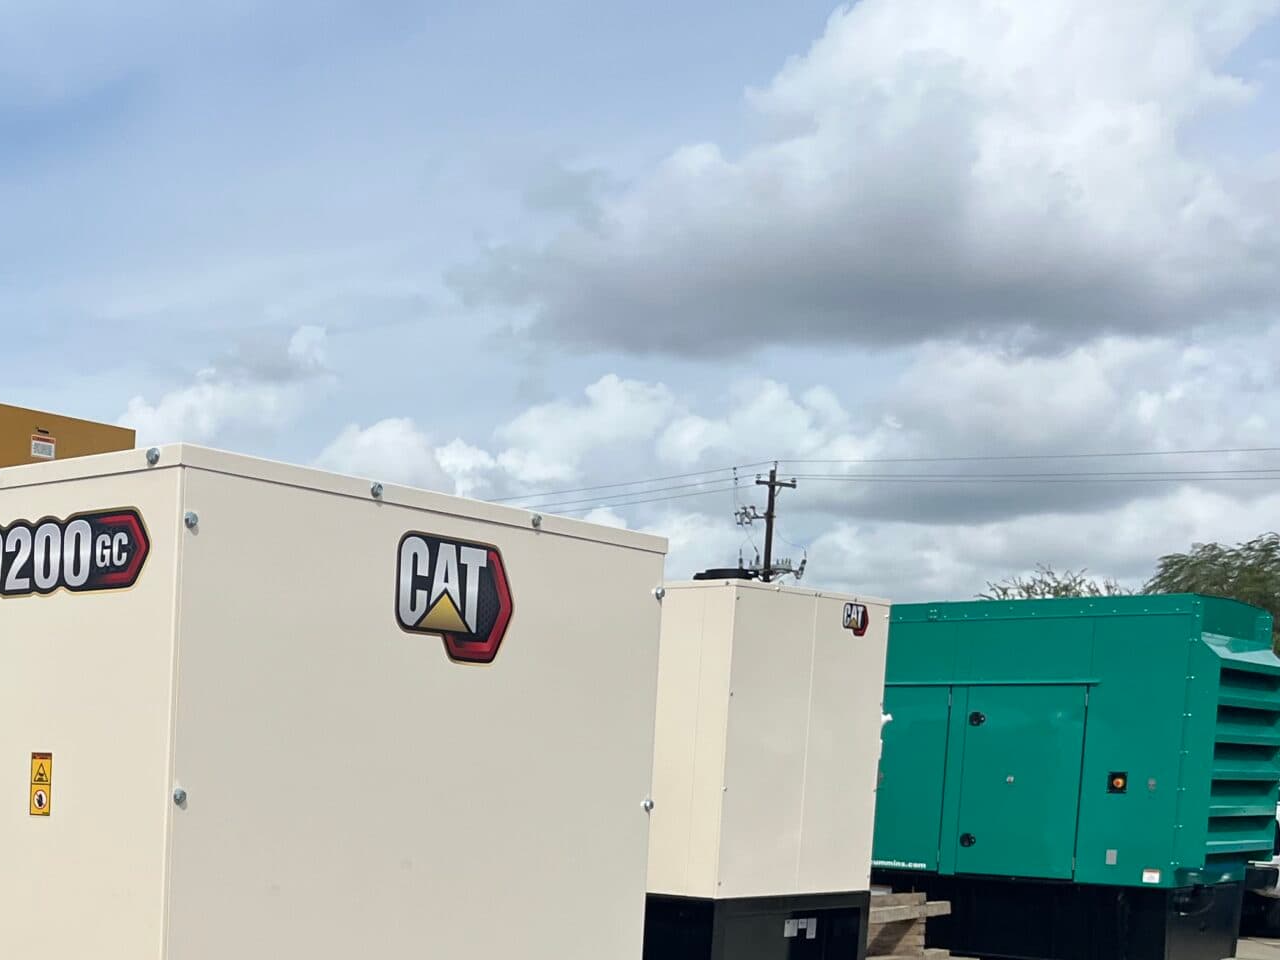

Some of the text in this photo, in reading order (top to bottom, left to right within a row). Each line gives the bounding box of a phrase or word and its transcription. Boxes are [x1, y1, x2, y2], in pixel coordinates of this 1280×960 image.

[95, 533, 128, 568] GC
[399, 536, 487, 634] CAT
[844, 604, 864, 629] CAT
[871, 859, 927, 869] ummins.com
